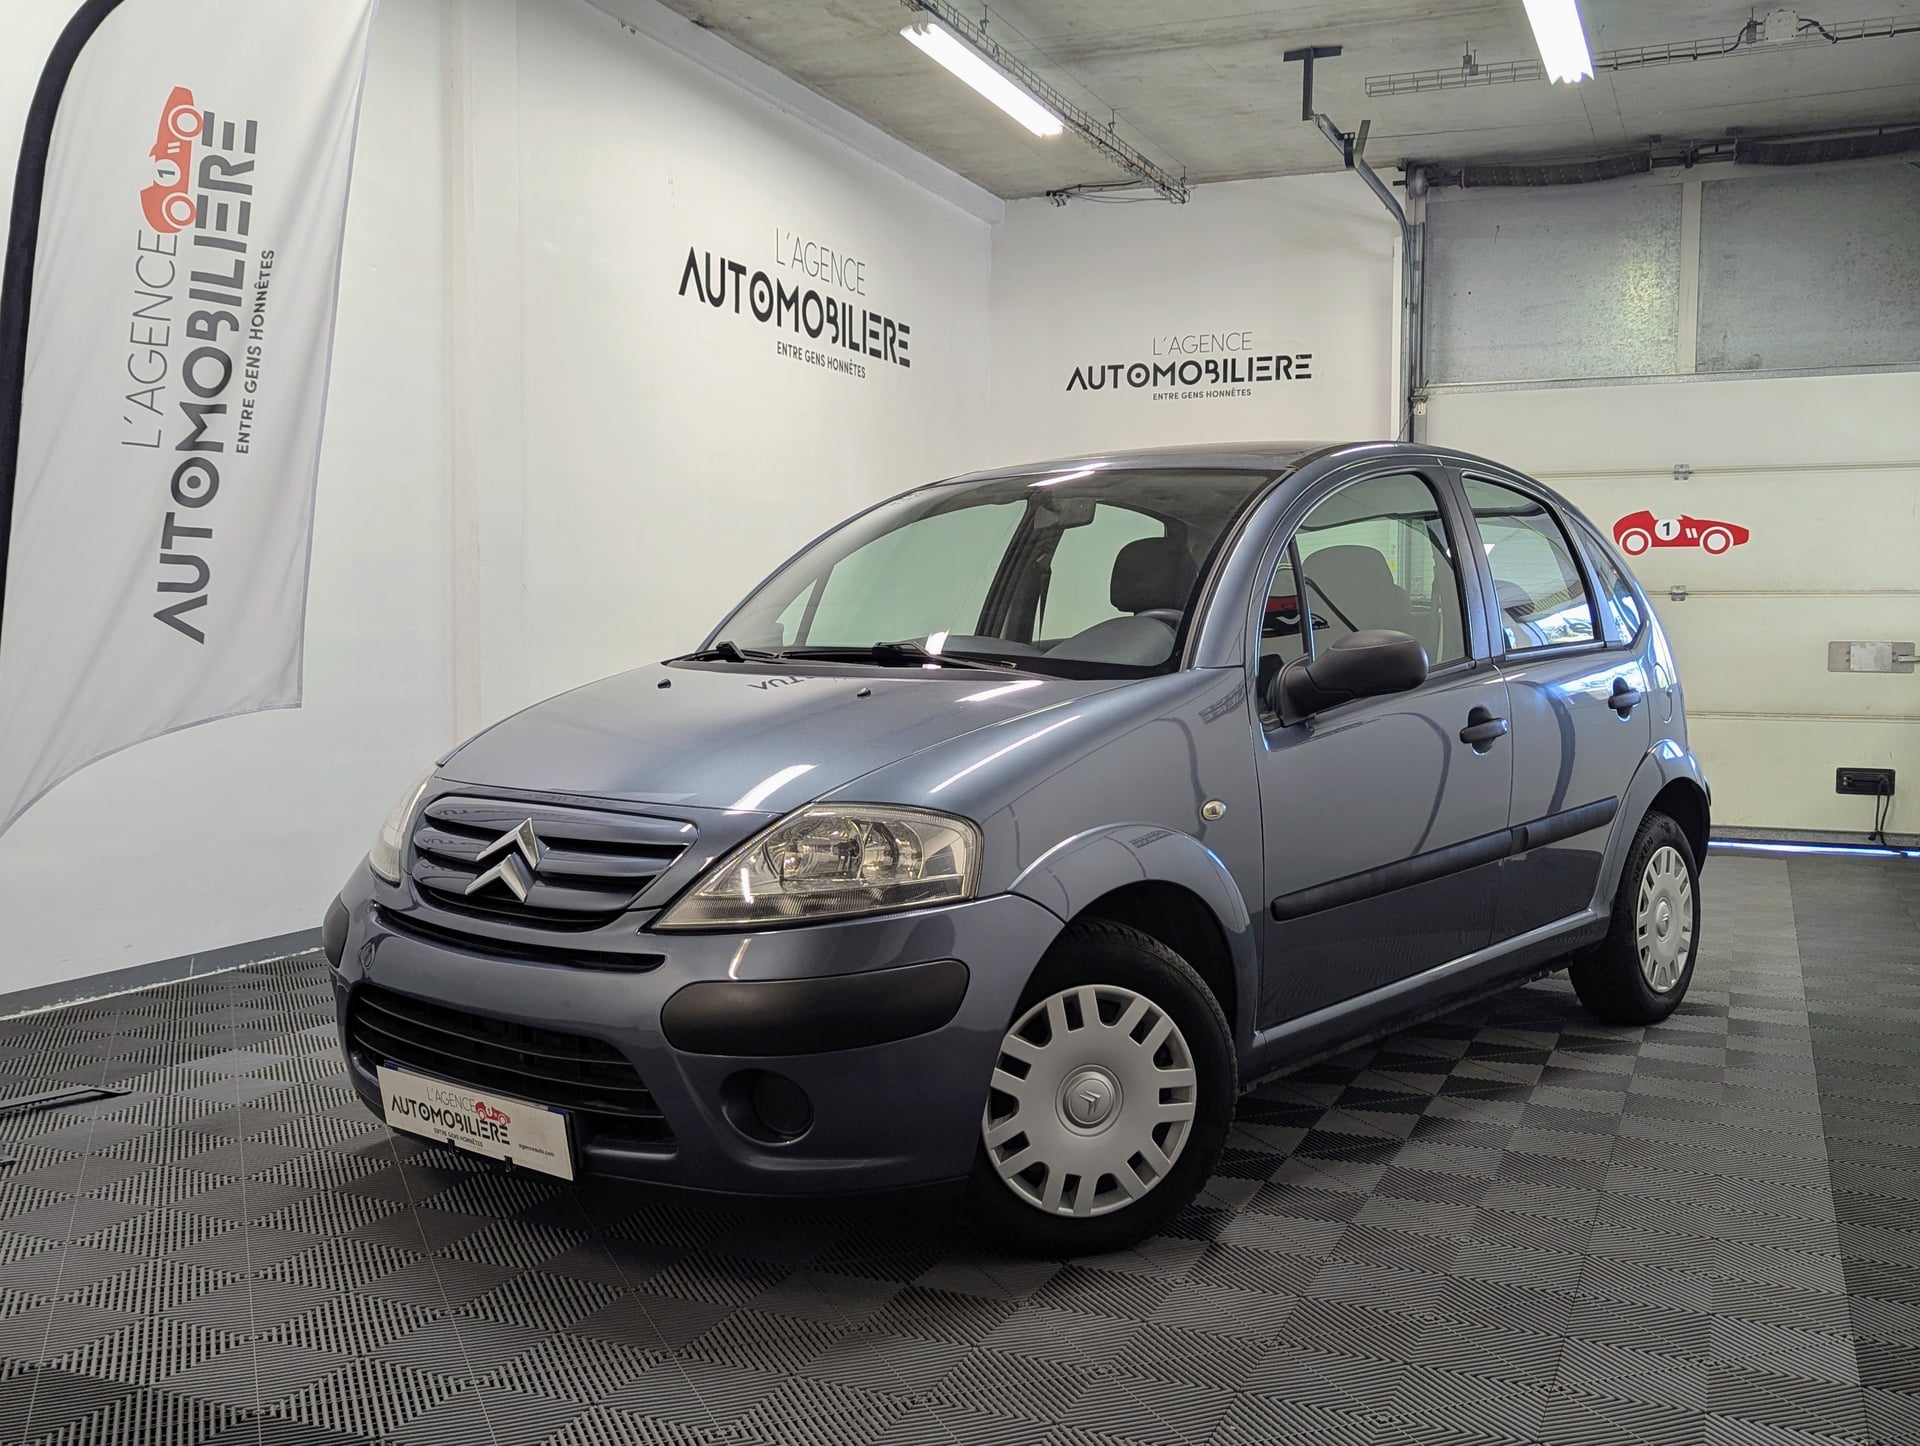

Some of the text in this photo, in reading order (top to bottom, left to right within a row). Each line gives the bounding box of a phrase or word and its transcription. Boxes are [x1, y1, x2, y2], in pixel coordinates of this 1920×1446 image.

[157, 169, 175, 178] 1
[776, 227, 866, 296] L'AGENCE
[678, 245, 911, 369] AUTOMOBILIERE
[121, 229, 178, 449] L'AGENCE
[236, 250, 275, 454] ENTRE GENS HONNÊTES
[1153, 331, 1253, 356] L'AGENCE
[153, 110, 258, 645] AUTOMOBILIERE
[777, 341, 866, 379] ENTRE GENS HONNÊTES
[1066, 353, 1313, 392] AUTOMOBILIERE
[1153, 387, 1252, 400] ENTRE GENS HONNÊTES
[1662, 522, 1670, 536] 1
[391, 1094, 511, 1146] AUTOMOBILIERE
[426, 1087, 477, 1114] L'AGENCE
